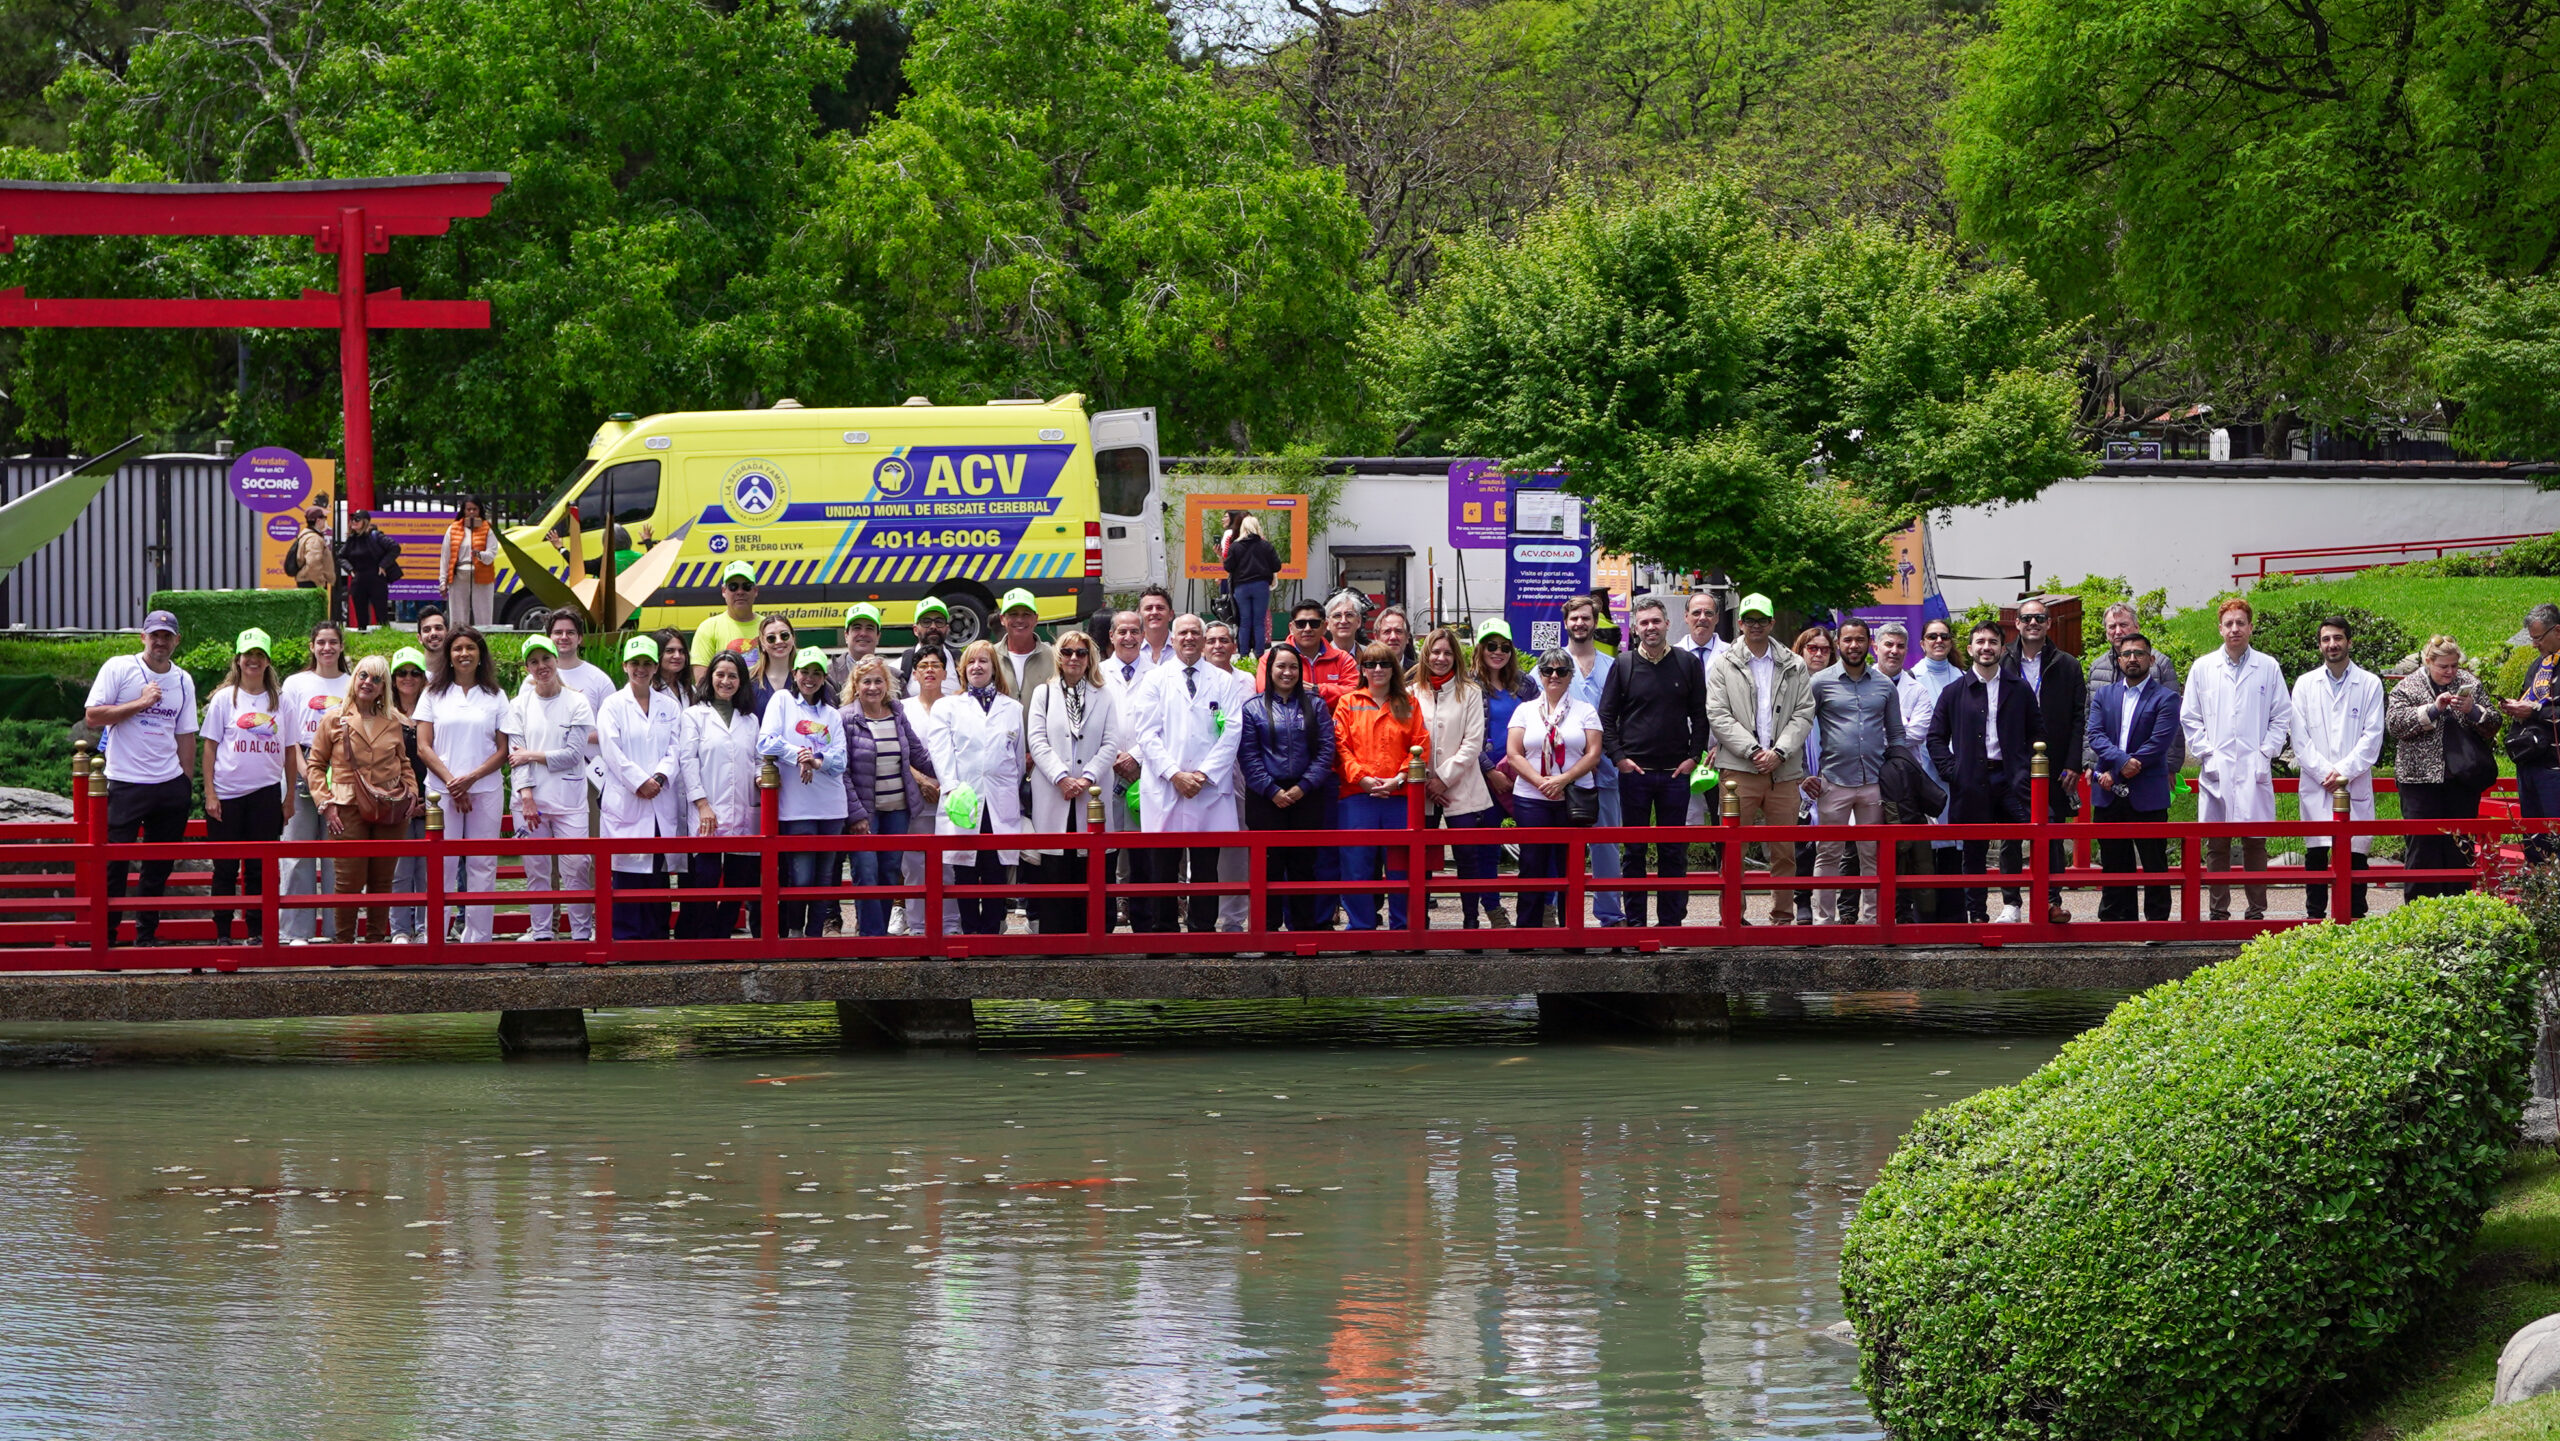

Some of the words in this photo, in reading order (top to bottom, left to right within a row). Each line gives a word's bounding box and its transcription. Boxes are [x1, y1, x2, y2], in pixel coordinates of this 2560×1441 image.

[251, 456, 289, 466] Acordate:
[728, 463, 763, 483] SAGRADA
[765, 467, 786, 494] FAMILIA
[924, 453, 1028, 495] ACV
[825, 505, 870, 517] UNIDAD
[874, 504, 912, 516] MOVIL
[915, 503, 931, 515] DE
[934, 502, 986, 515] RESCATE
[988, 501, 1051, 513] CEREBRAL
[734, 534, 761, 543] ENERI
[871, 530, 1001, 548] 4014-6006
[734, 544, 749, 552] DR.
[750, 543, 778, 551] PEDRO
[1520, 550, 1575, 558] ACV.COM.AR
[233, 740, 246, 753] NO
[250, 740, 261, 753] AL
